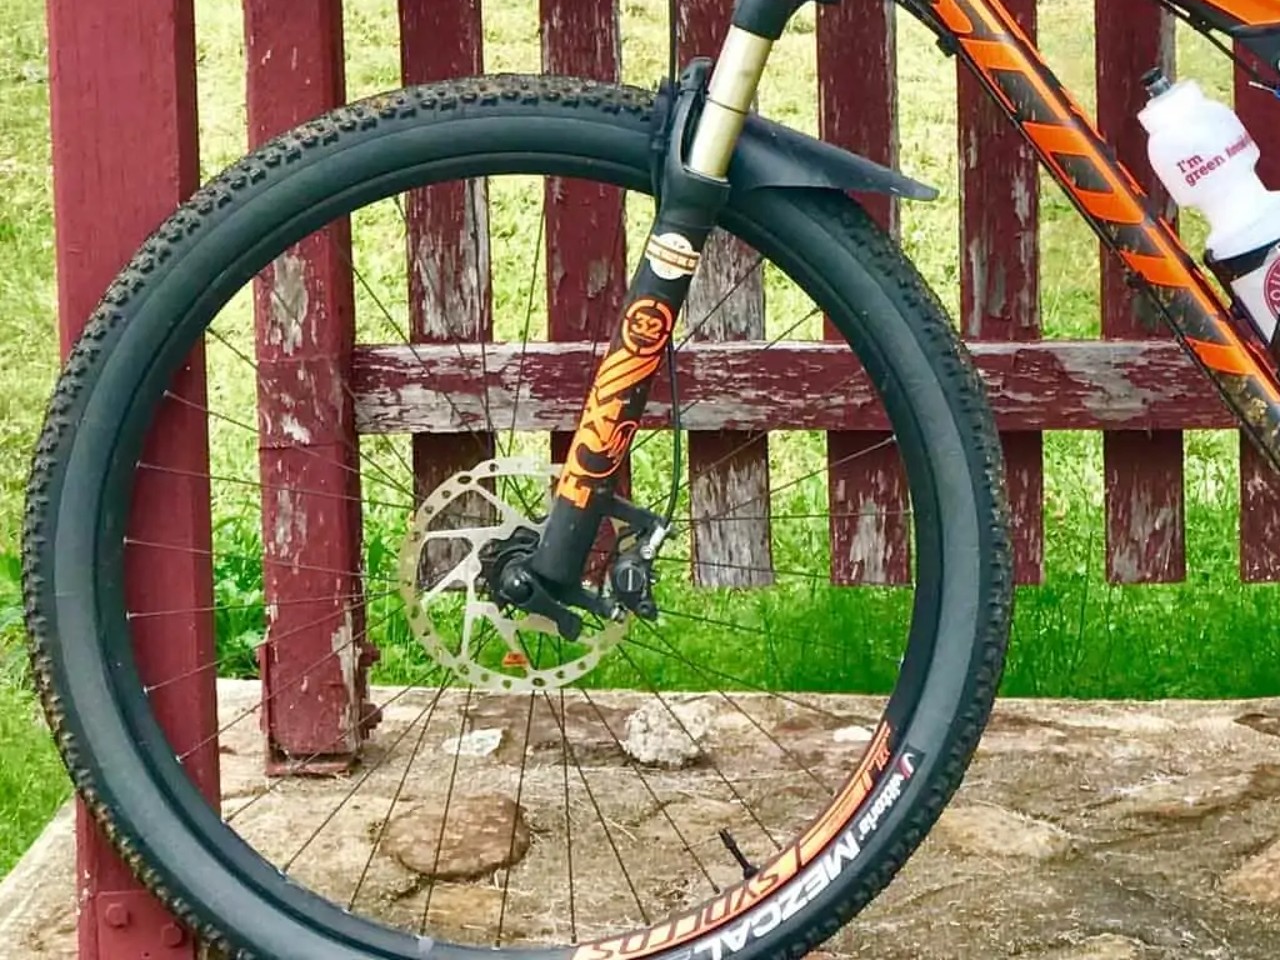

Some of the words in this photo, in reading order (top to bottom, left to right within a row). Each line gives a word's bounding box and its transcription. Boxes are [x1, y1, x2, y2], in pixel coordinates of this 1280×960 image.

[1177, 154, 1203, 173] I'm
[1185, 155, 1226, 187] green
[631, 310, 663, 340] 32
[556, 389, 638, 509] FOX
[695, 831, 862, 960] MEZCAL
